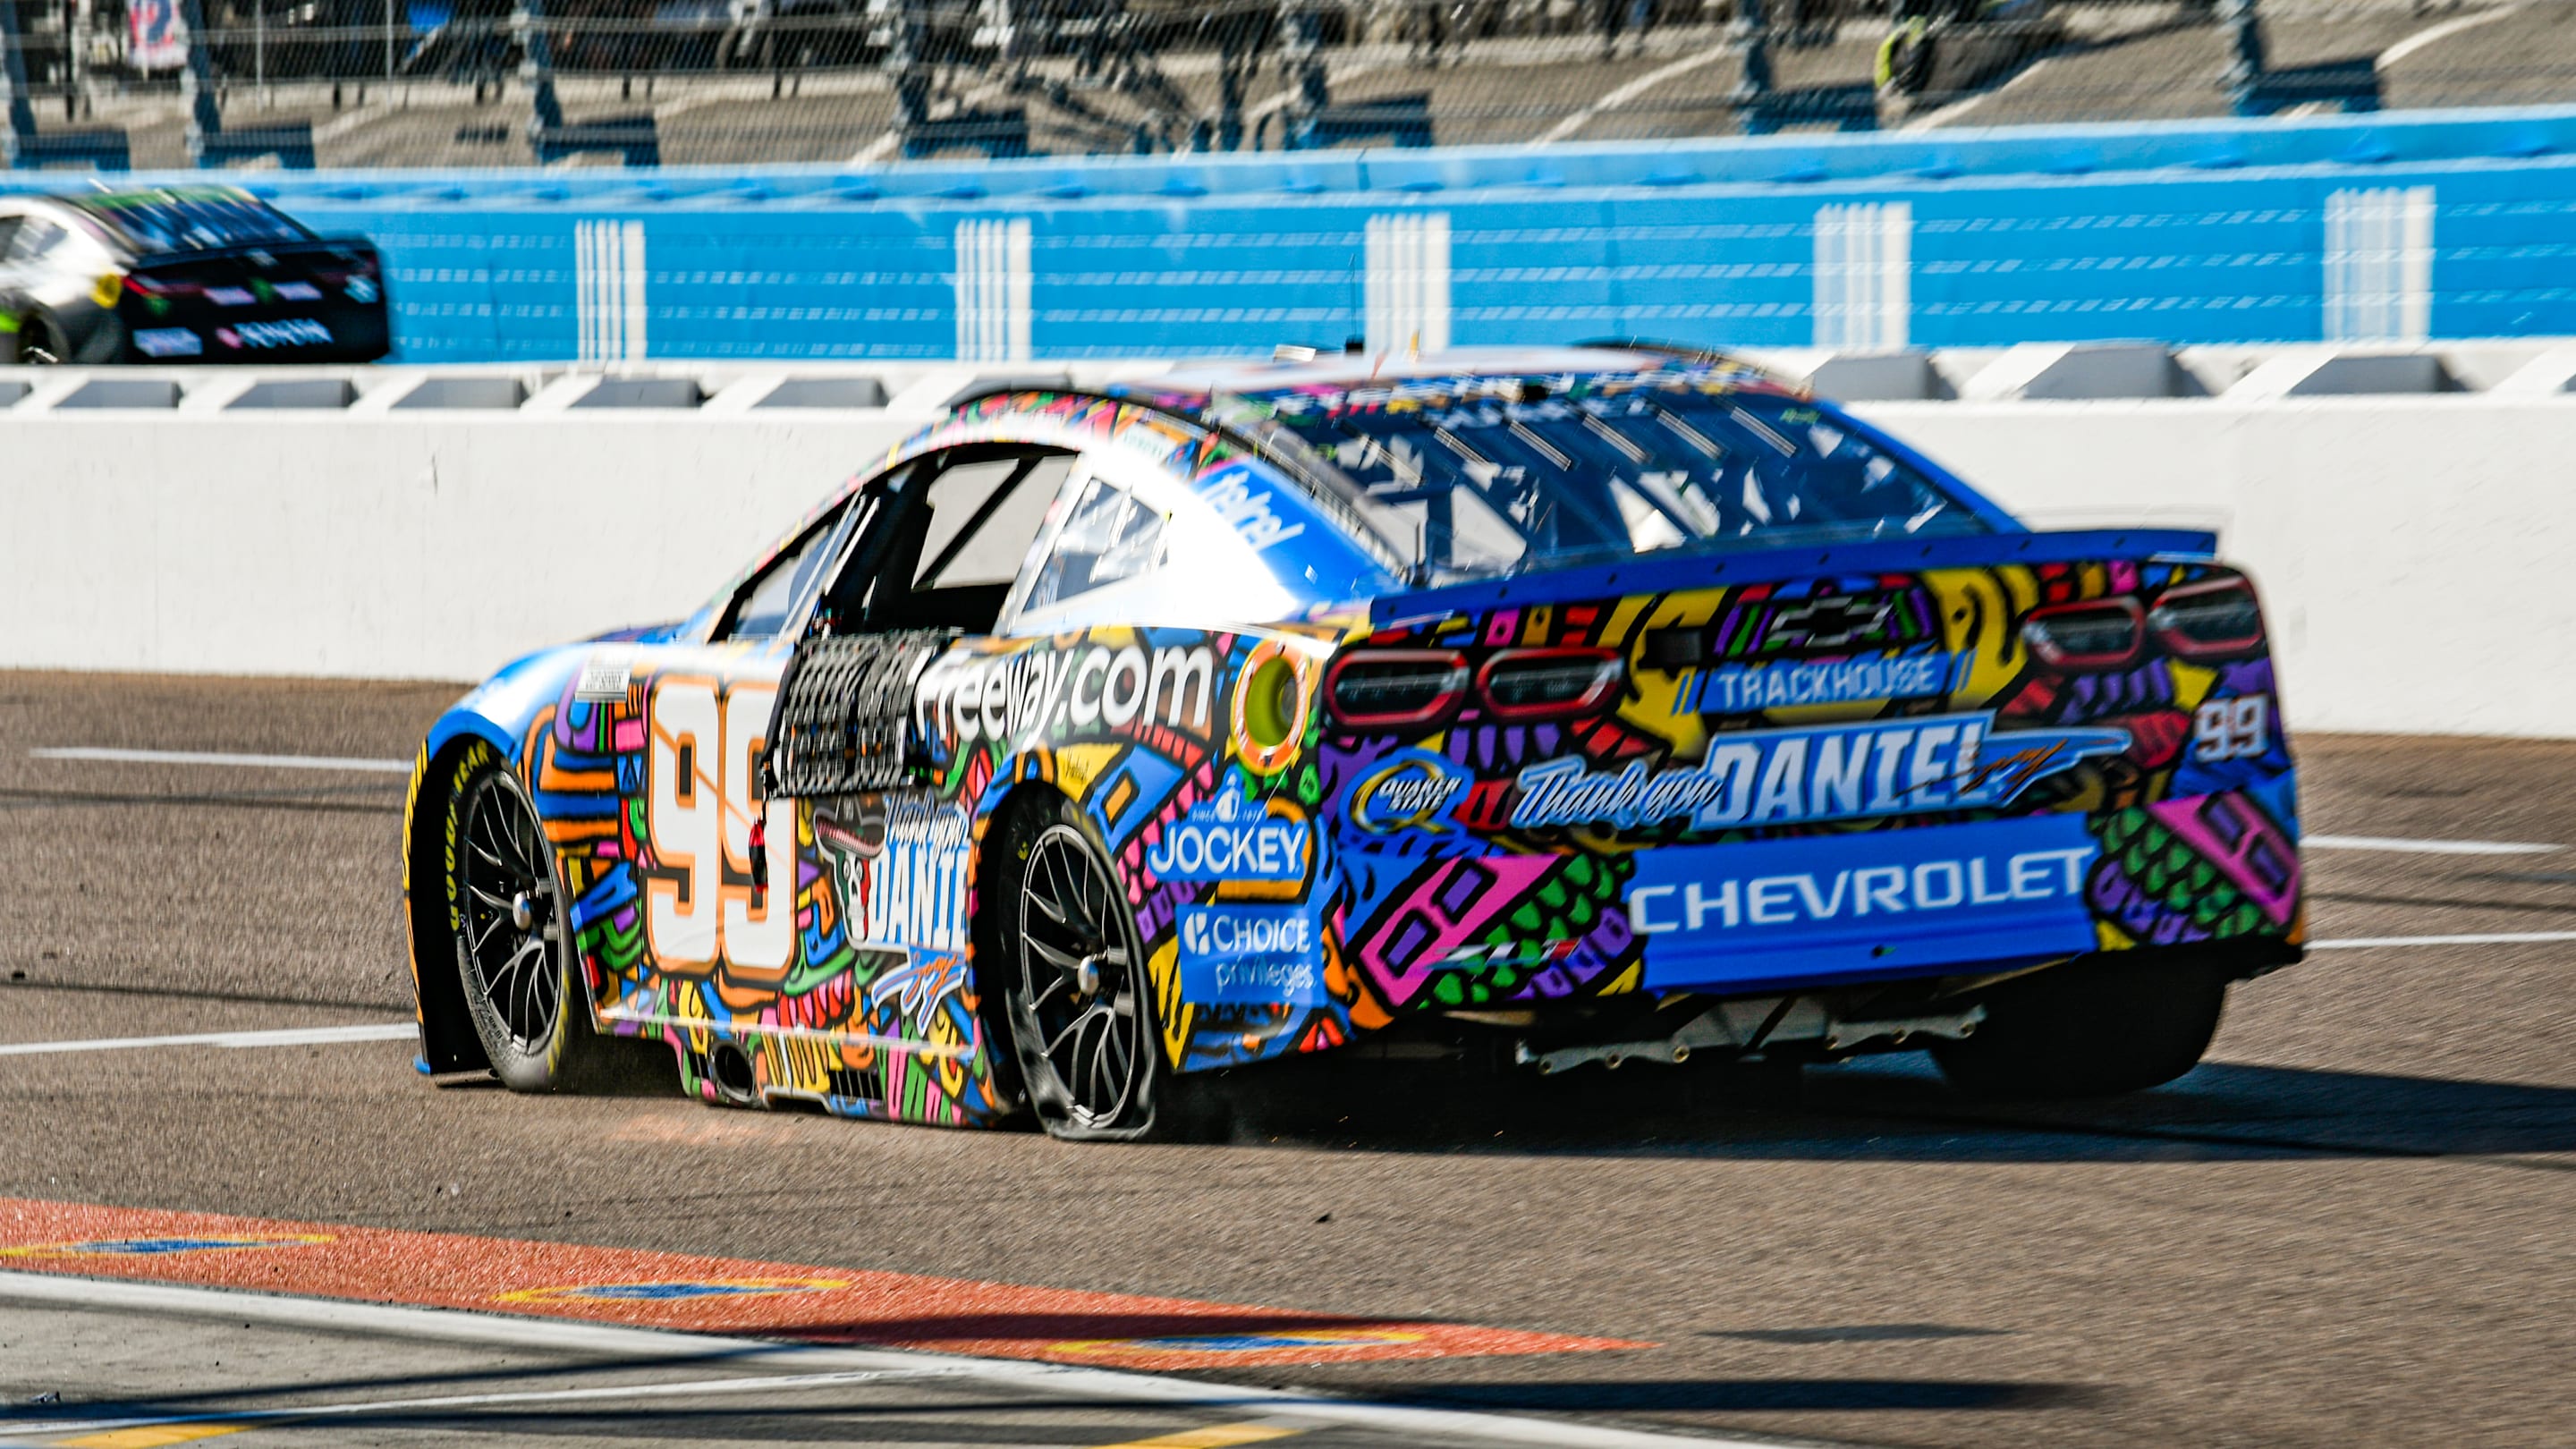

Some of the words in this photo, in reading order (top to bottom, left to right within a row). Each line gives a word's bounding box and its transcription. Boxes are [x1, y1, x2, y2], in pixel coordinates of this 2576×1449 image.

[914, 645, 1214, 752] Freeway.com
[1717, 656, 1939, 708] TRACKHOUSE
[2195, 694, 2270, 763] 99
[1378, 776, 1462, 798] QUAKER
[1514, 758, 1644, 826] Thank
[1705, 722, 1988, 822] DANIEL
[648, 677, 796, 979] 99
[1386, 792, 1445, 812] STATE
[1150, 825, 1301, 875] JOCKEY
[1629, 845, 2096, 935] CHEVROLET
[1212, 915, 1311, 954] CHOICE
[1215, 954, 1314, 997] privileges
